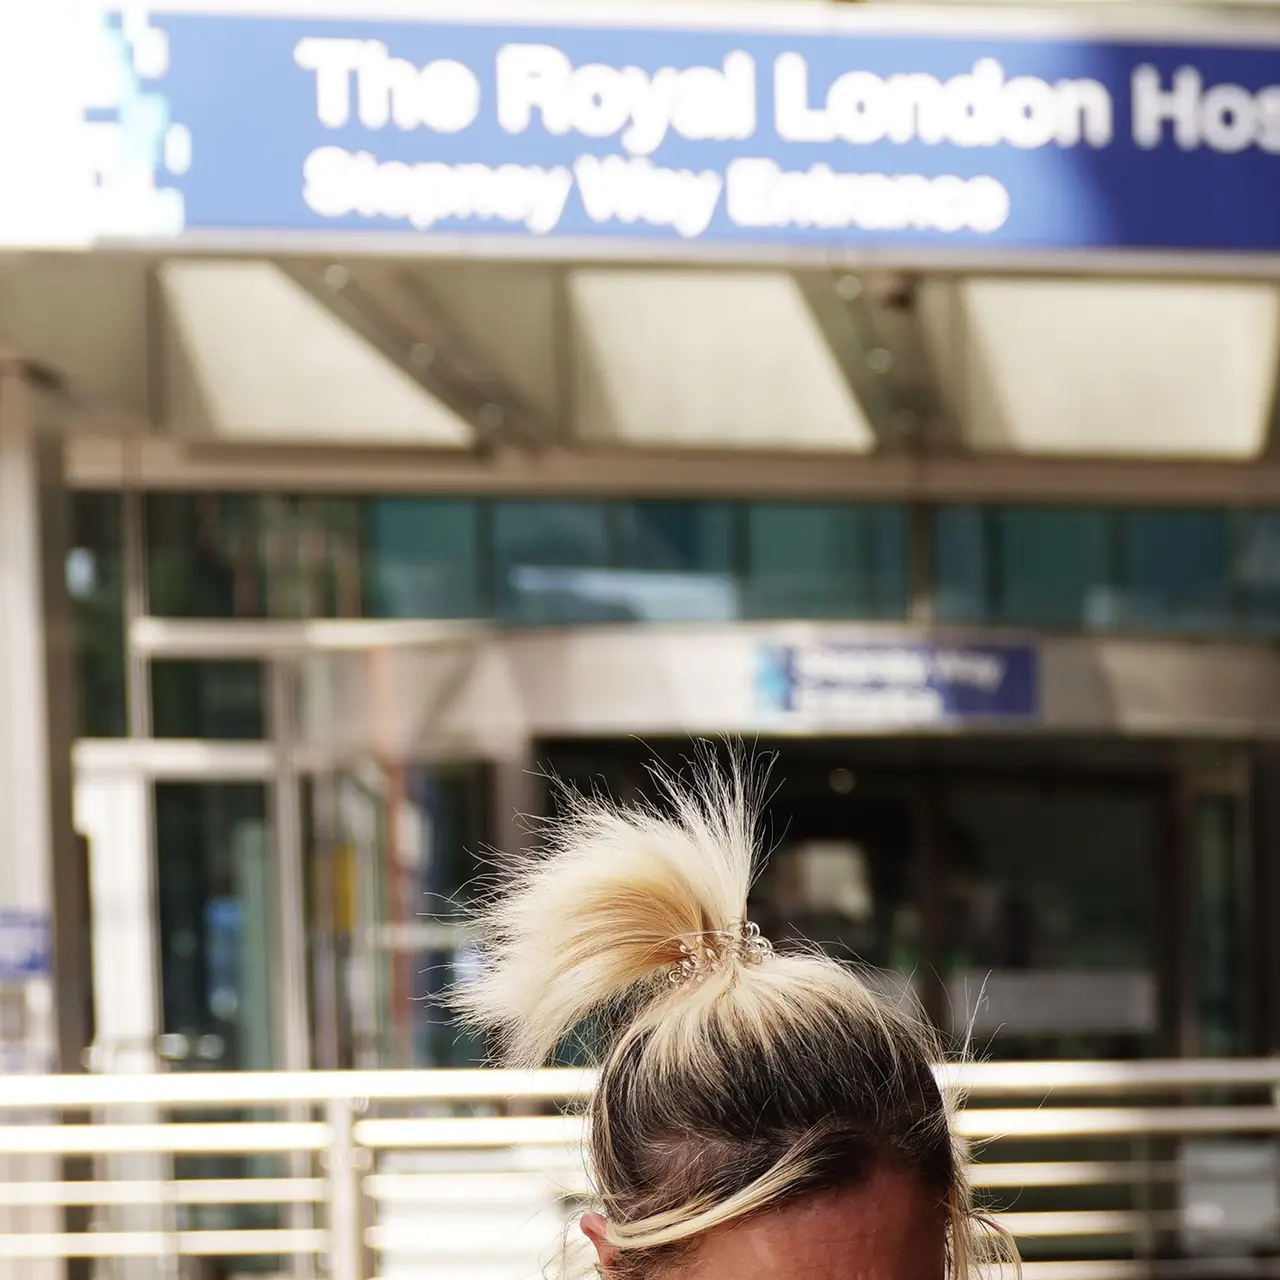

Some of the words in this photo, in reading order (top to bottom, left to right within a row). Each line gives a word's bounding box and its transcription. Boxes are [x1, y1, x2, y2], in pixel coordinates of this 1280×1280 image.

[294, 37, 480, 133] The
[496, 43, 756, 155] Royal
[774, 51, 1112, 148] London
